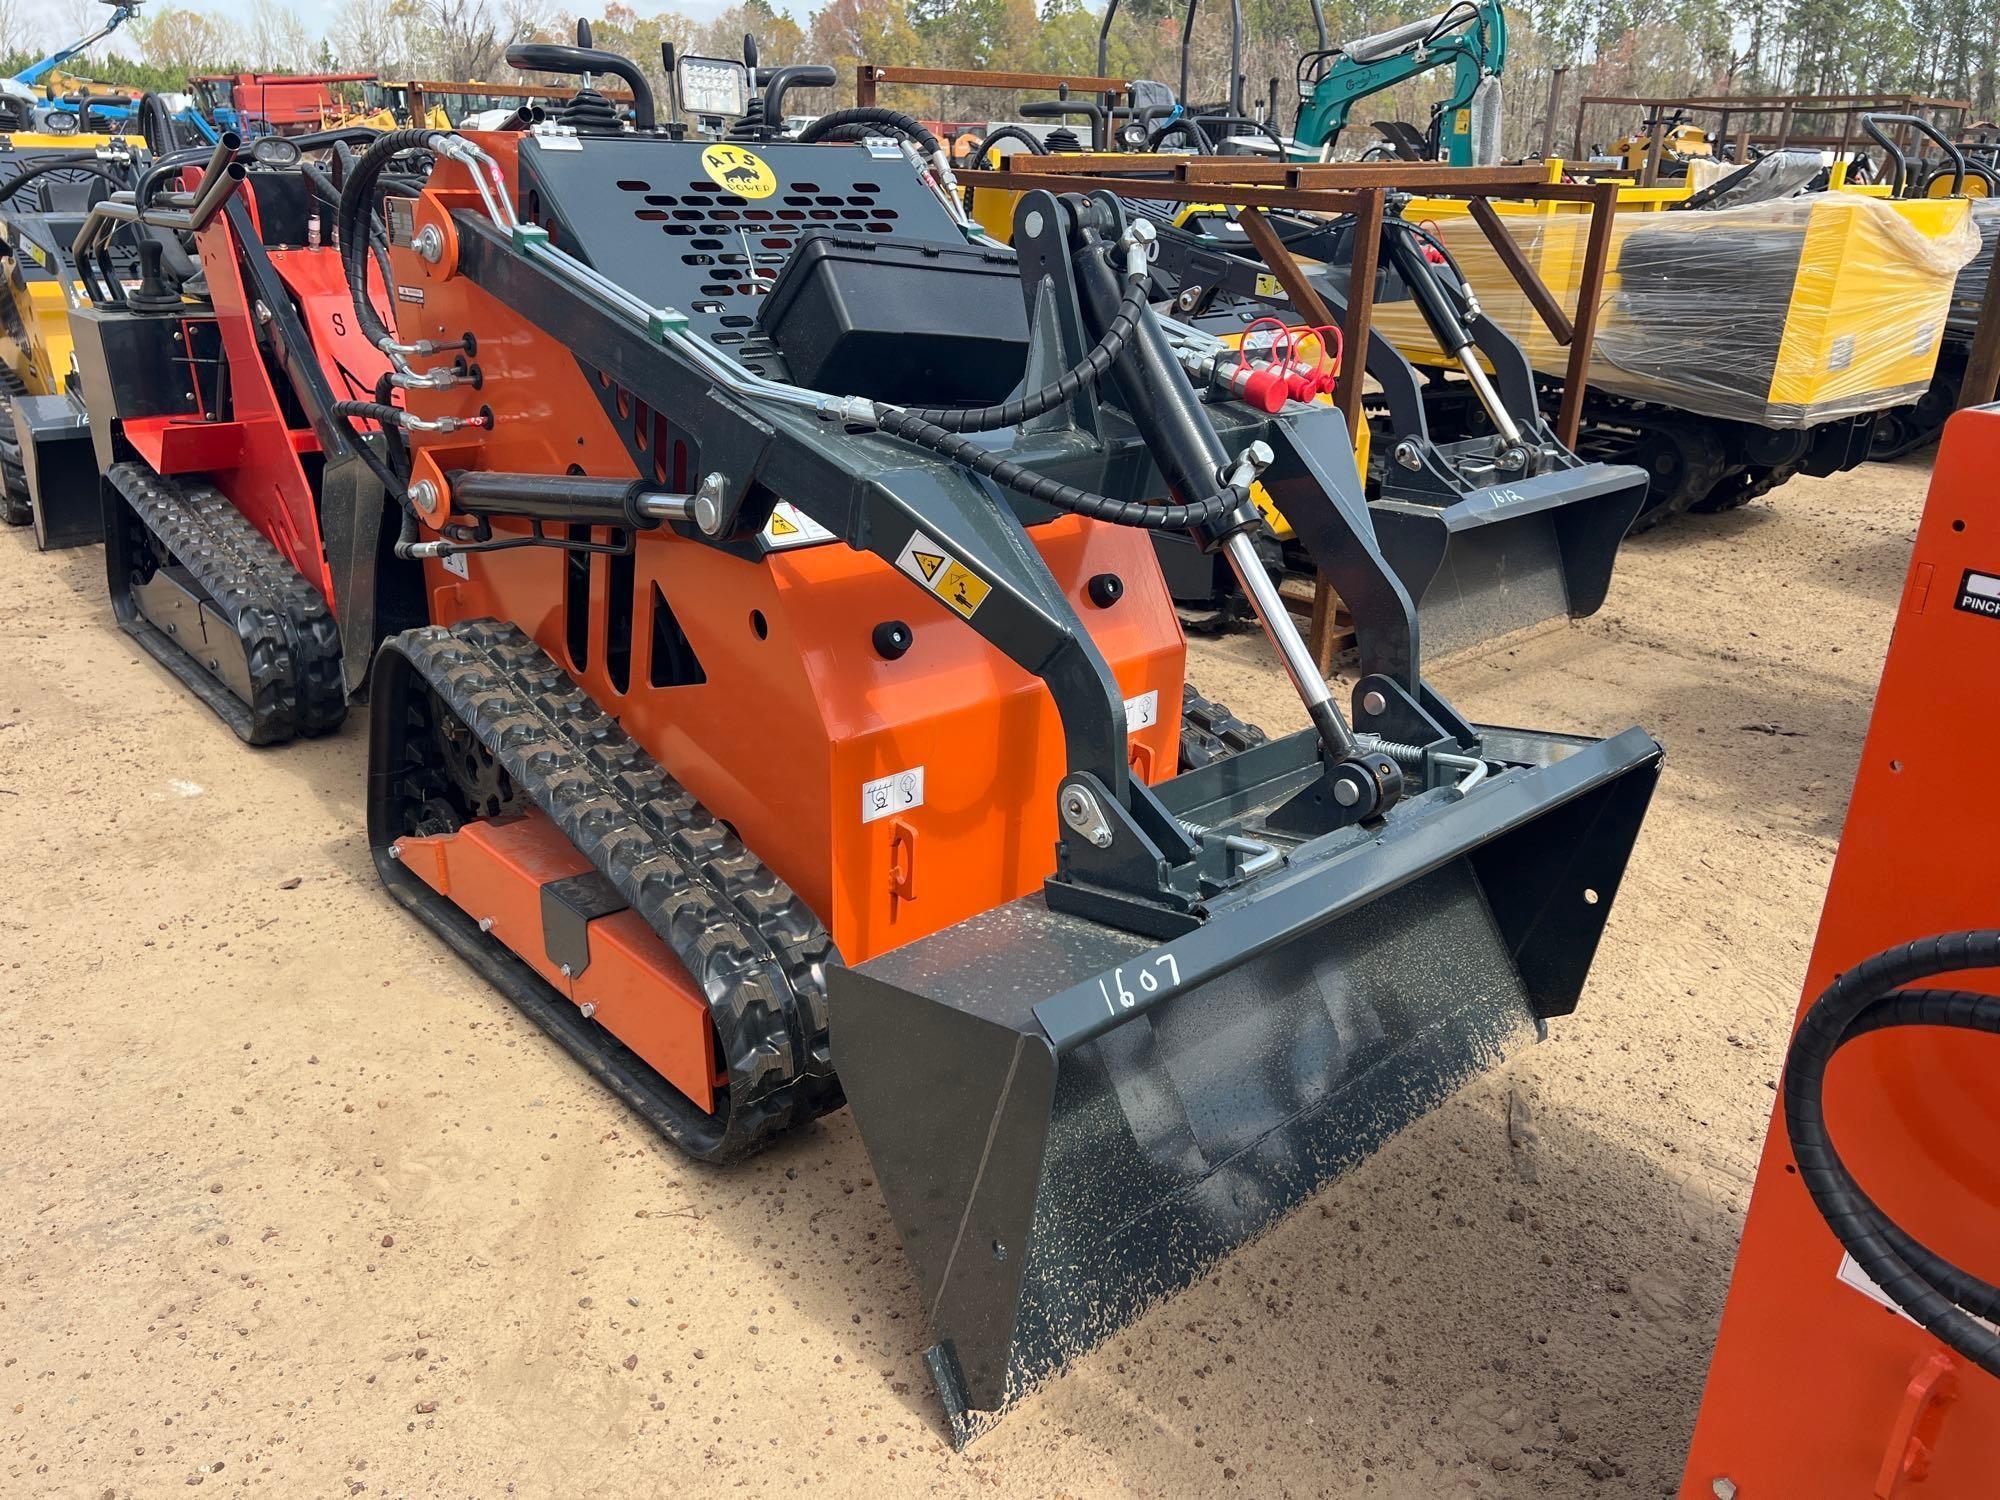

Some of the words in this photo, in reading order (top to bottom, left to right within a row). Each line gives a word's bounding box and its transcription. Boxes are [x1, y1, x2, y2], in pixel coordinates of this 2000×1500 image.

[707, 151, 756, 168] ATS
[727, 184, 770, 192] POWER
[1488, 489, 1525, 508] 1612
[1099, 953, 1180, 1016] 1607
